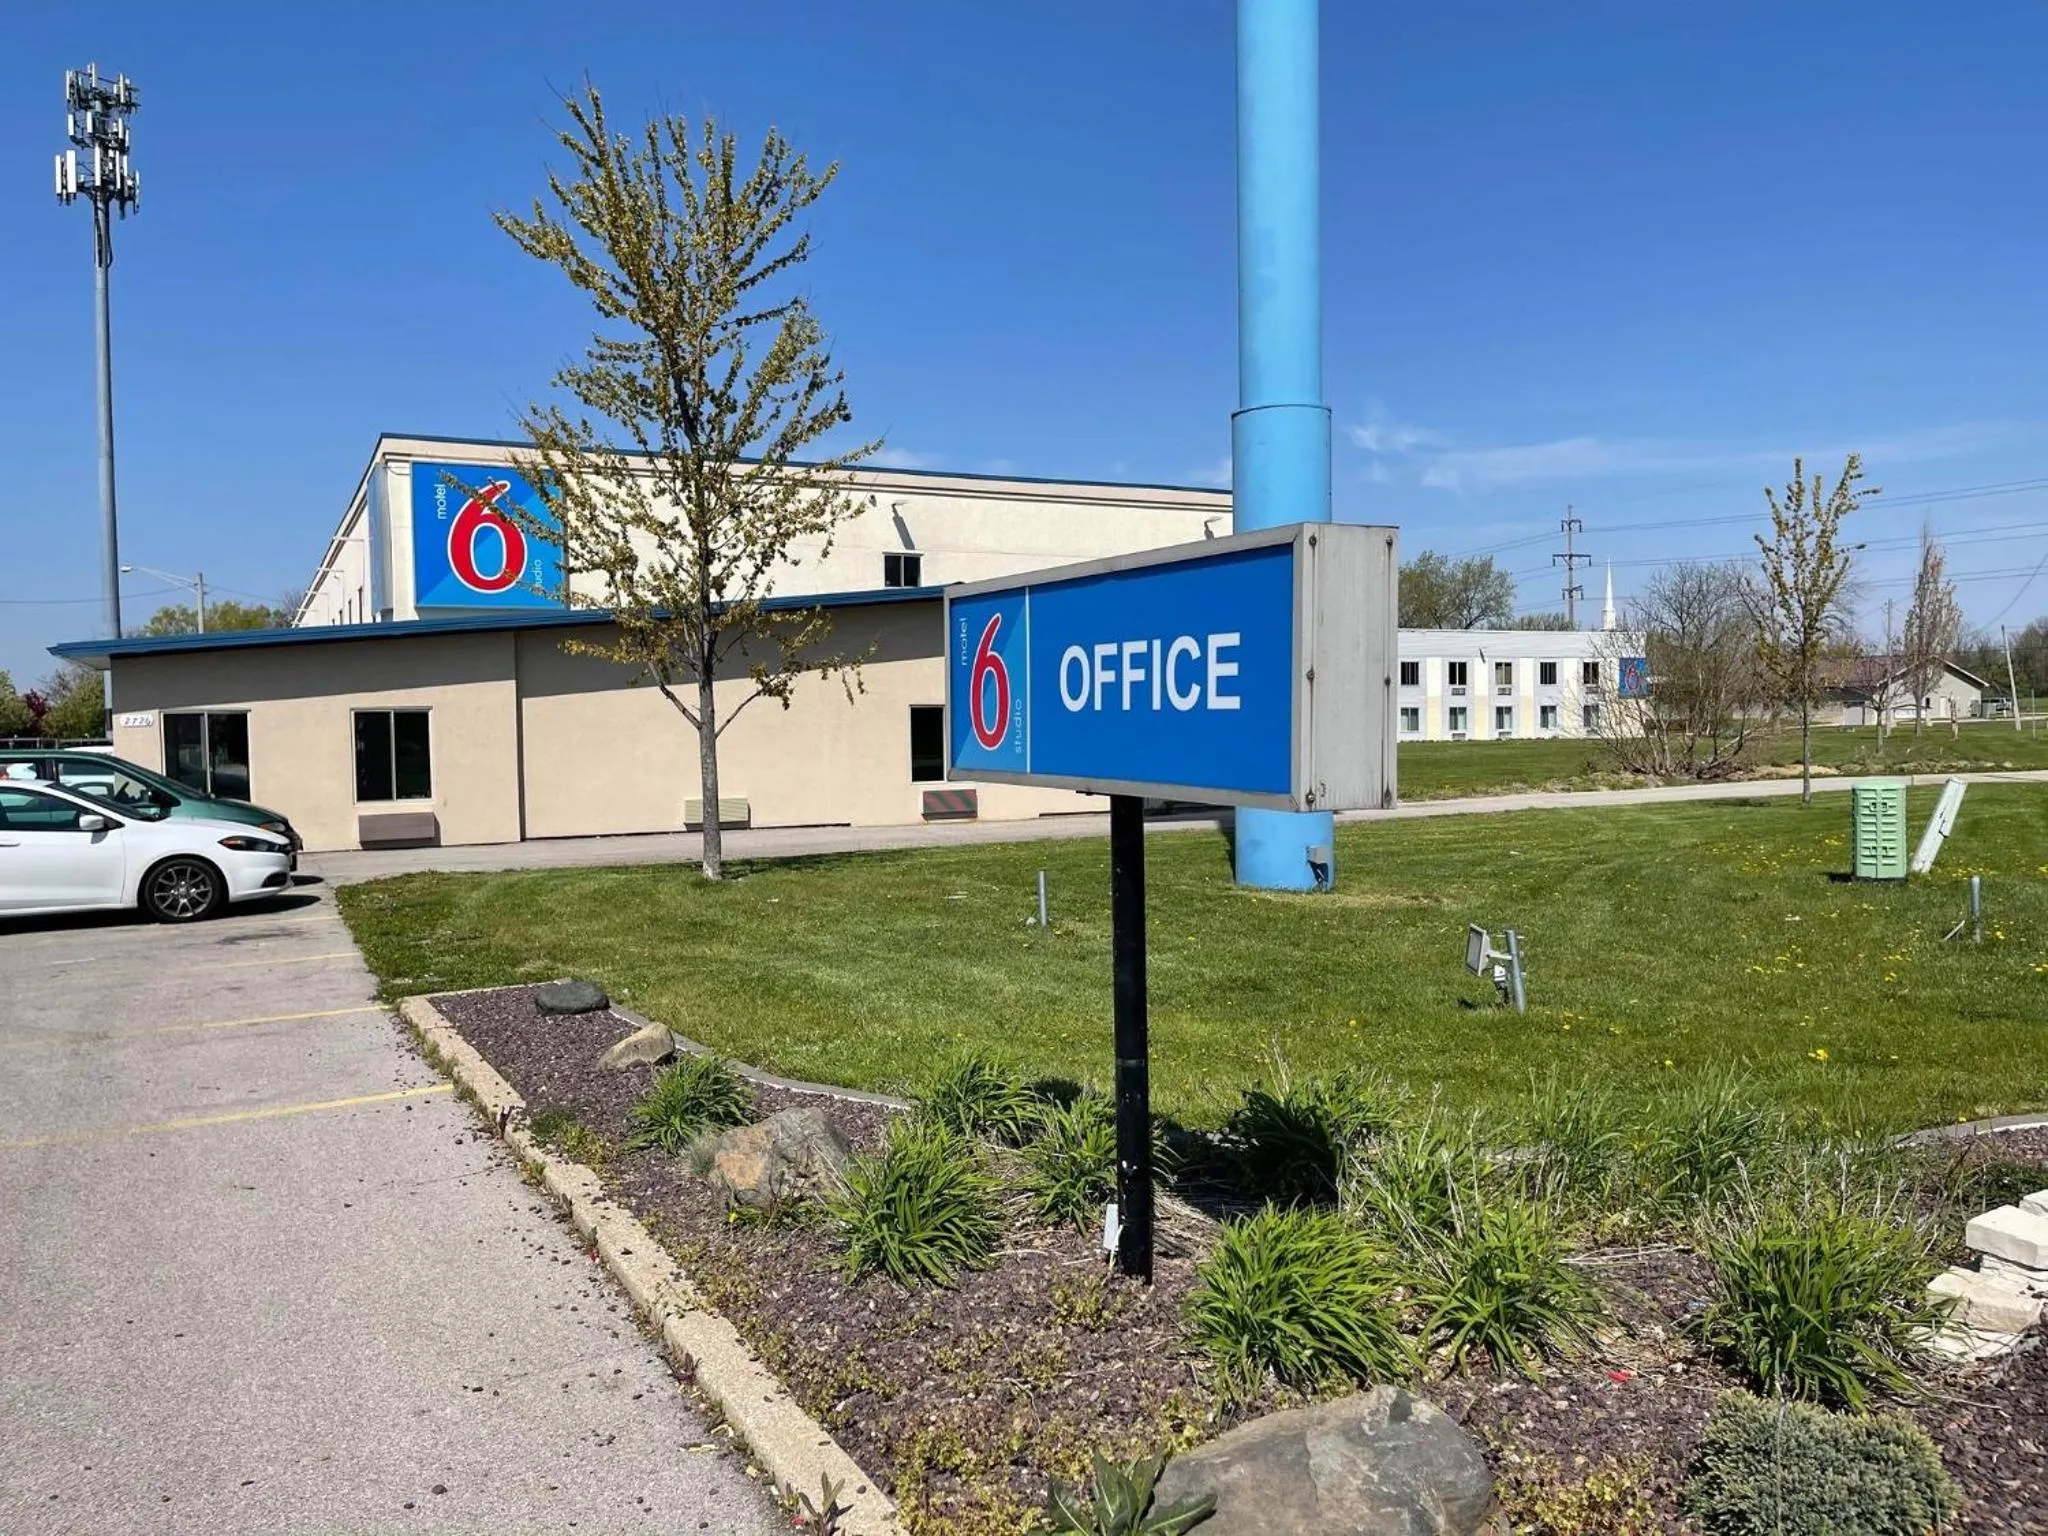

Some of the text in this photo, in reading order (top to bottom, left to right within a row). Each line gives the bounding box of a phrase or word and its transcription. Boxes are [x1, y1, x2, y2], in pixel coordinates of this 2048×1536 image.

[434, 484, 447, 519] motel
[447, 480, 528, 593] 6
[959, 617, 968, 666] motel
[1059, 632, 1241, 712] OFFICE
[970, 612, 1011, 751] 6
[1013, 699, 1022, 754] studio
